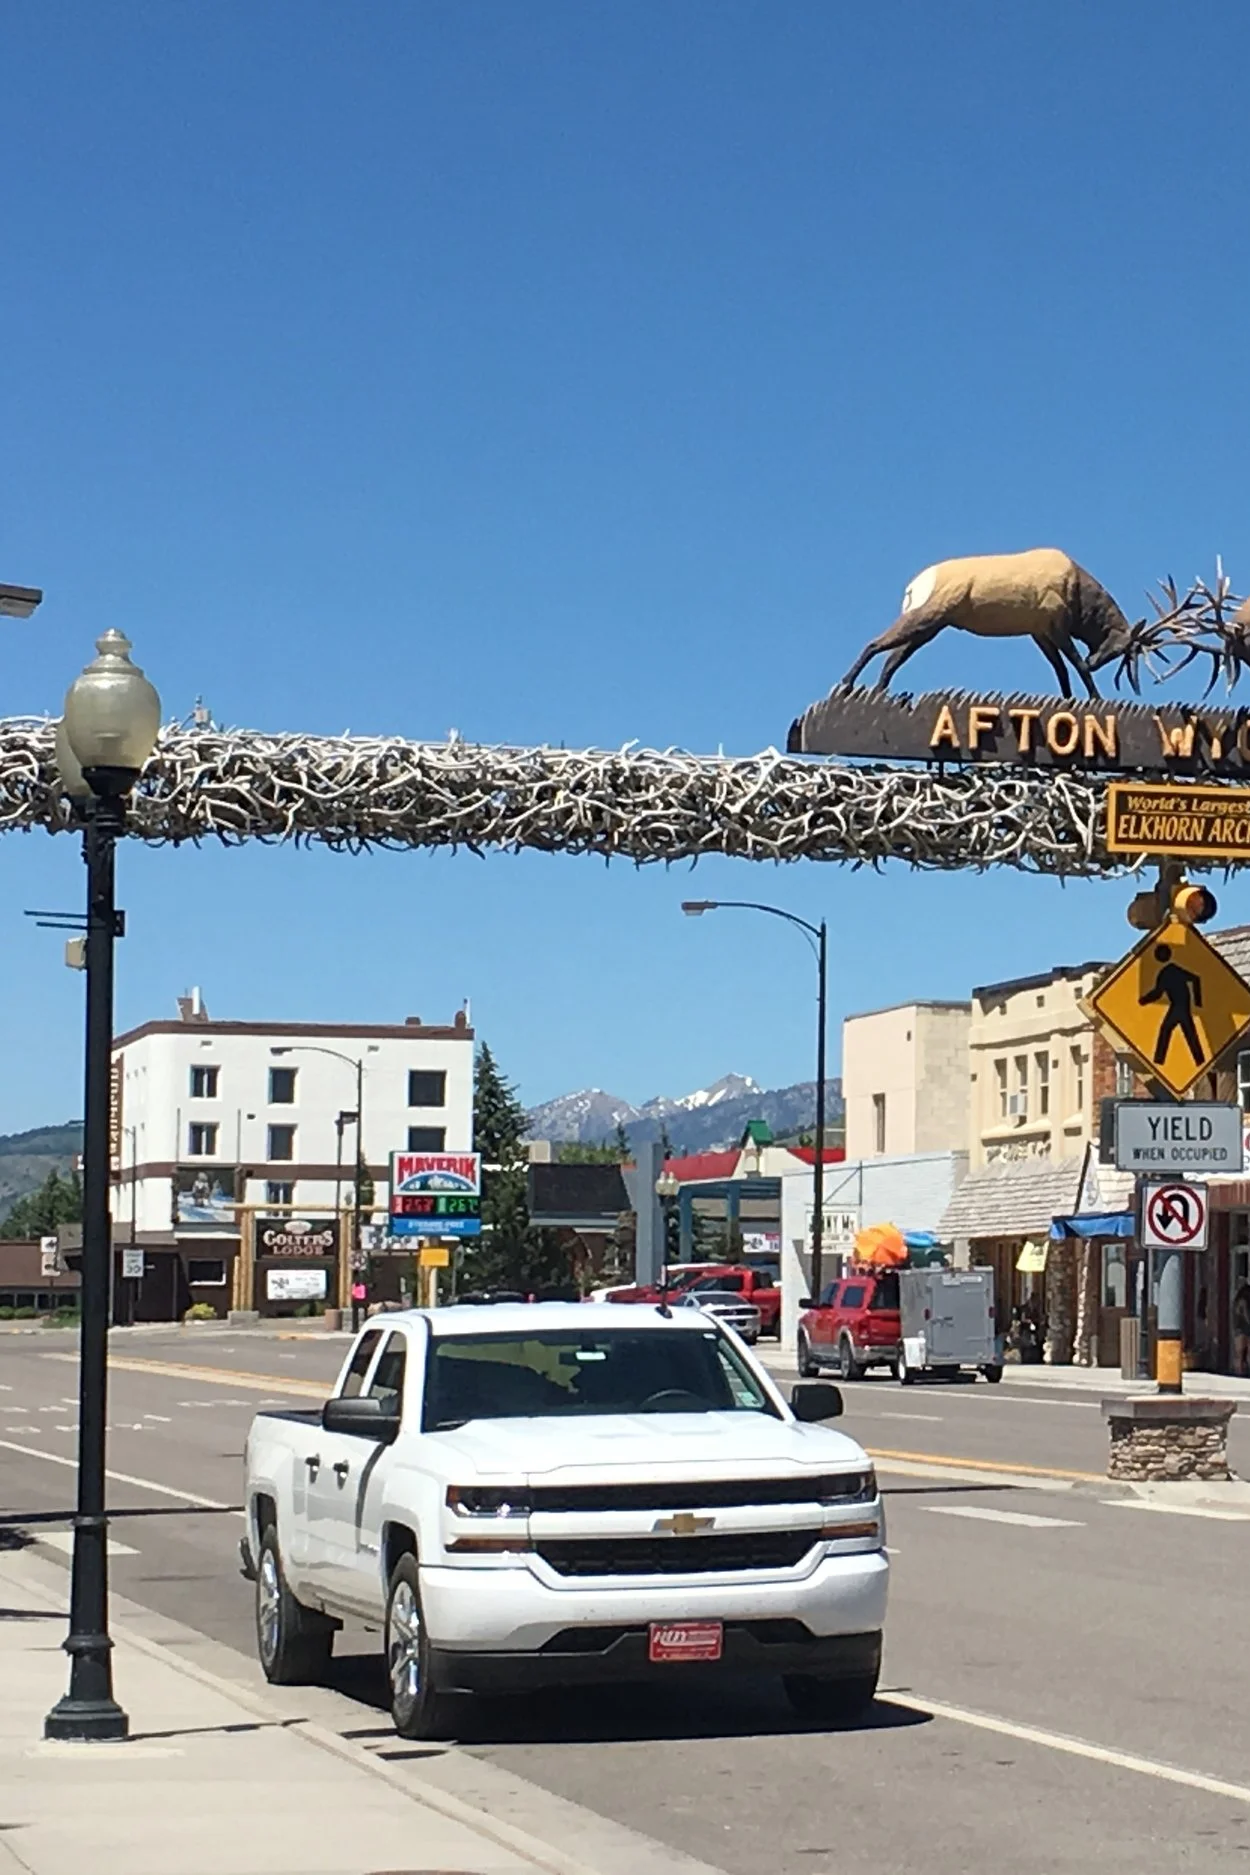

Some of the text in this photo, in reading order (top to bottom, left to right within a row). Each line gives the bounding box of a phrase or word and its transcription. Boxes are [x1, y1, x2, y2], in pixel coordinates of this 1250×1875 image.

[929, 705, 1117, 758] AFTON
[1127, 795, 1187, 811] World's
[1118, 814, 1205, 842] ELKHORN
[1147, 1116, 1213, 1141] YIELD
[1132, 1147, 1228, 1160] WHEN OCCUPIED
[397, 1156, 477, 1186] MAVERIK
[272, 1245, 325, 1256] LODGE
